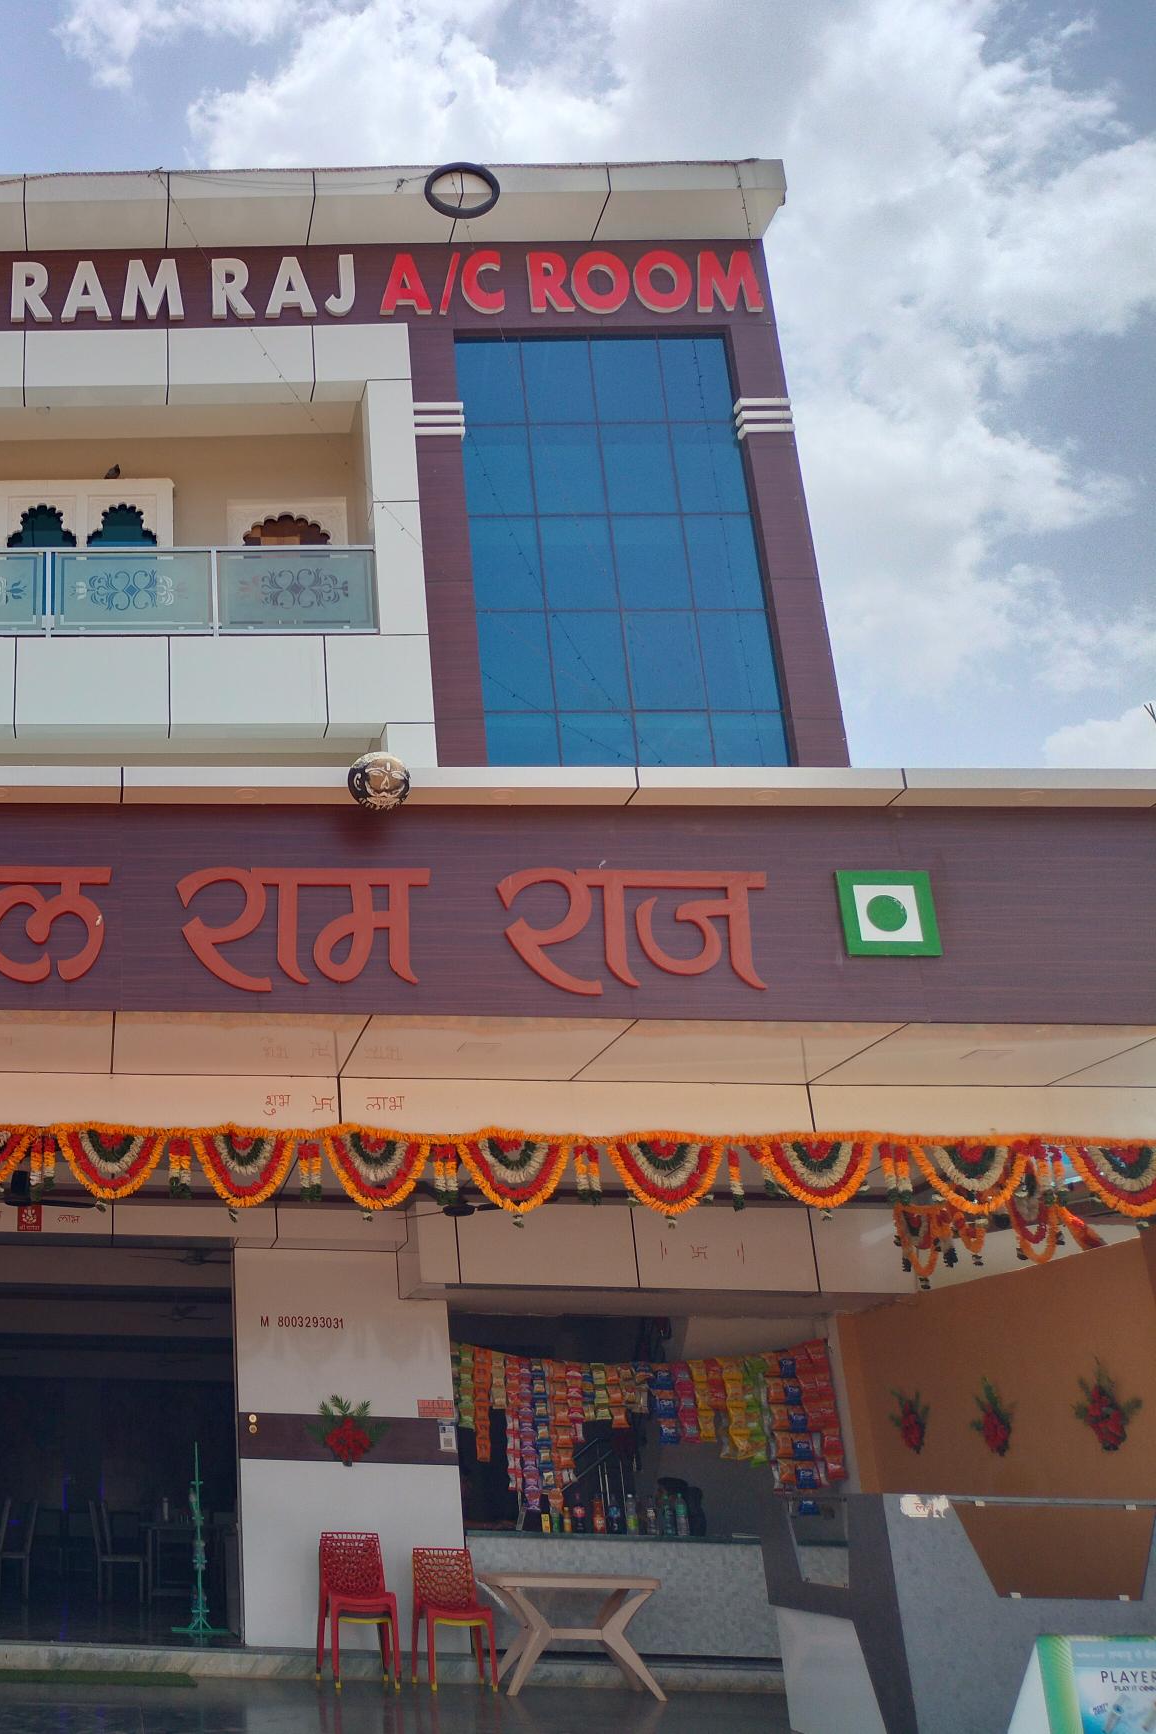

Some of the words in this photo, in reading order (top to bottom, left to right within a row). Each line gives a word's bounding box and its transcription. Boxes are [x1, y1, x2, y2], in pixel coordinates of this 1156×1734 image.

[10, 258, 185, 323] RAM
[211, 254, 356, 320] RAJ
[379, 249, 505, 316] A/C
[526, 248, 764, 315] ROOM
[176, 867, 431, 992] राम
[496, 867, 768, 996] राज
[263, 1094, 291, 1116] शुभ
[366, 1095, 405, 1111] लाभ
[260, 1315, 269, 1327] M
[277, 1315, 344, 1329] 8003293031
